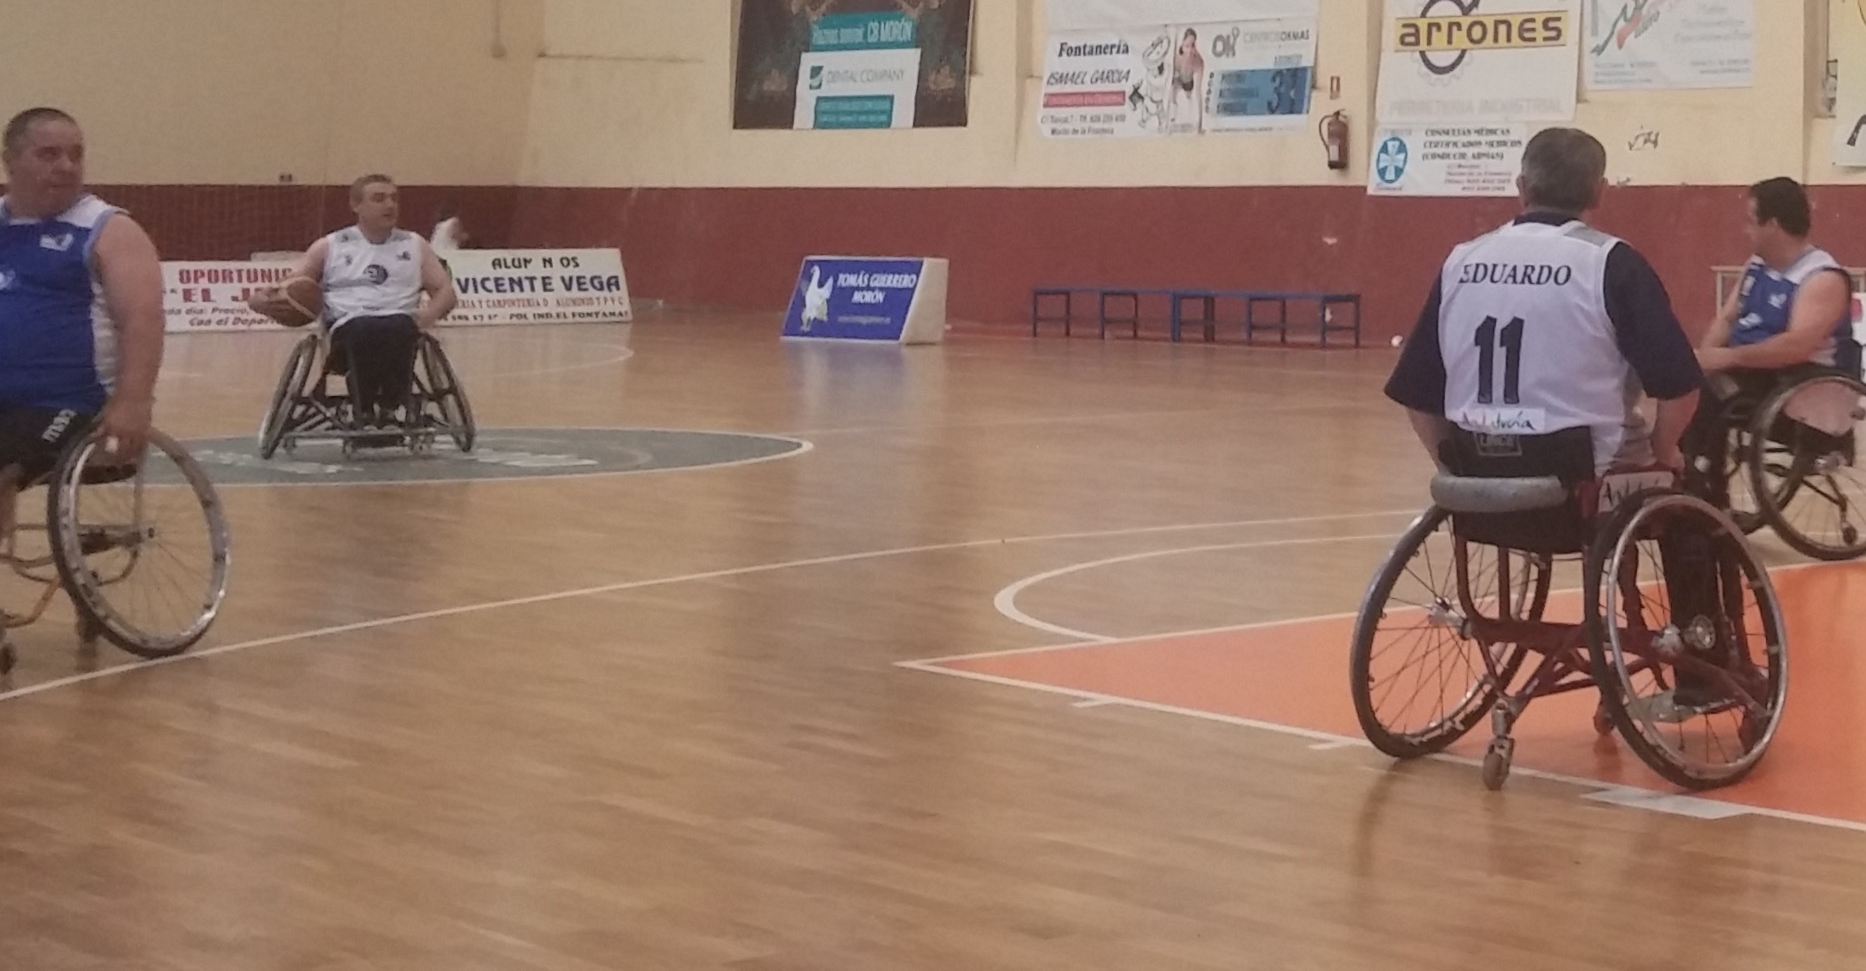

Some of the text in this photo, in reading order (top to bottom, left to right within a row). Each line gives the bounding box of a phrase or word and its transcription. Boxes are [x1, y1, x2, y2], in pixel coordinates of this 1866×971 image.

[1399, 16, 1563, 48] arrones
[1047, 71, 1088, 86] ISMAEL
[456, 275, 621, 294] VICENTE VEGA
[1458, 263, 1572, 286] EDUARDO
[1474, 315, 1526, 405] 11
